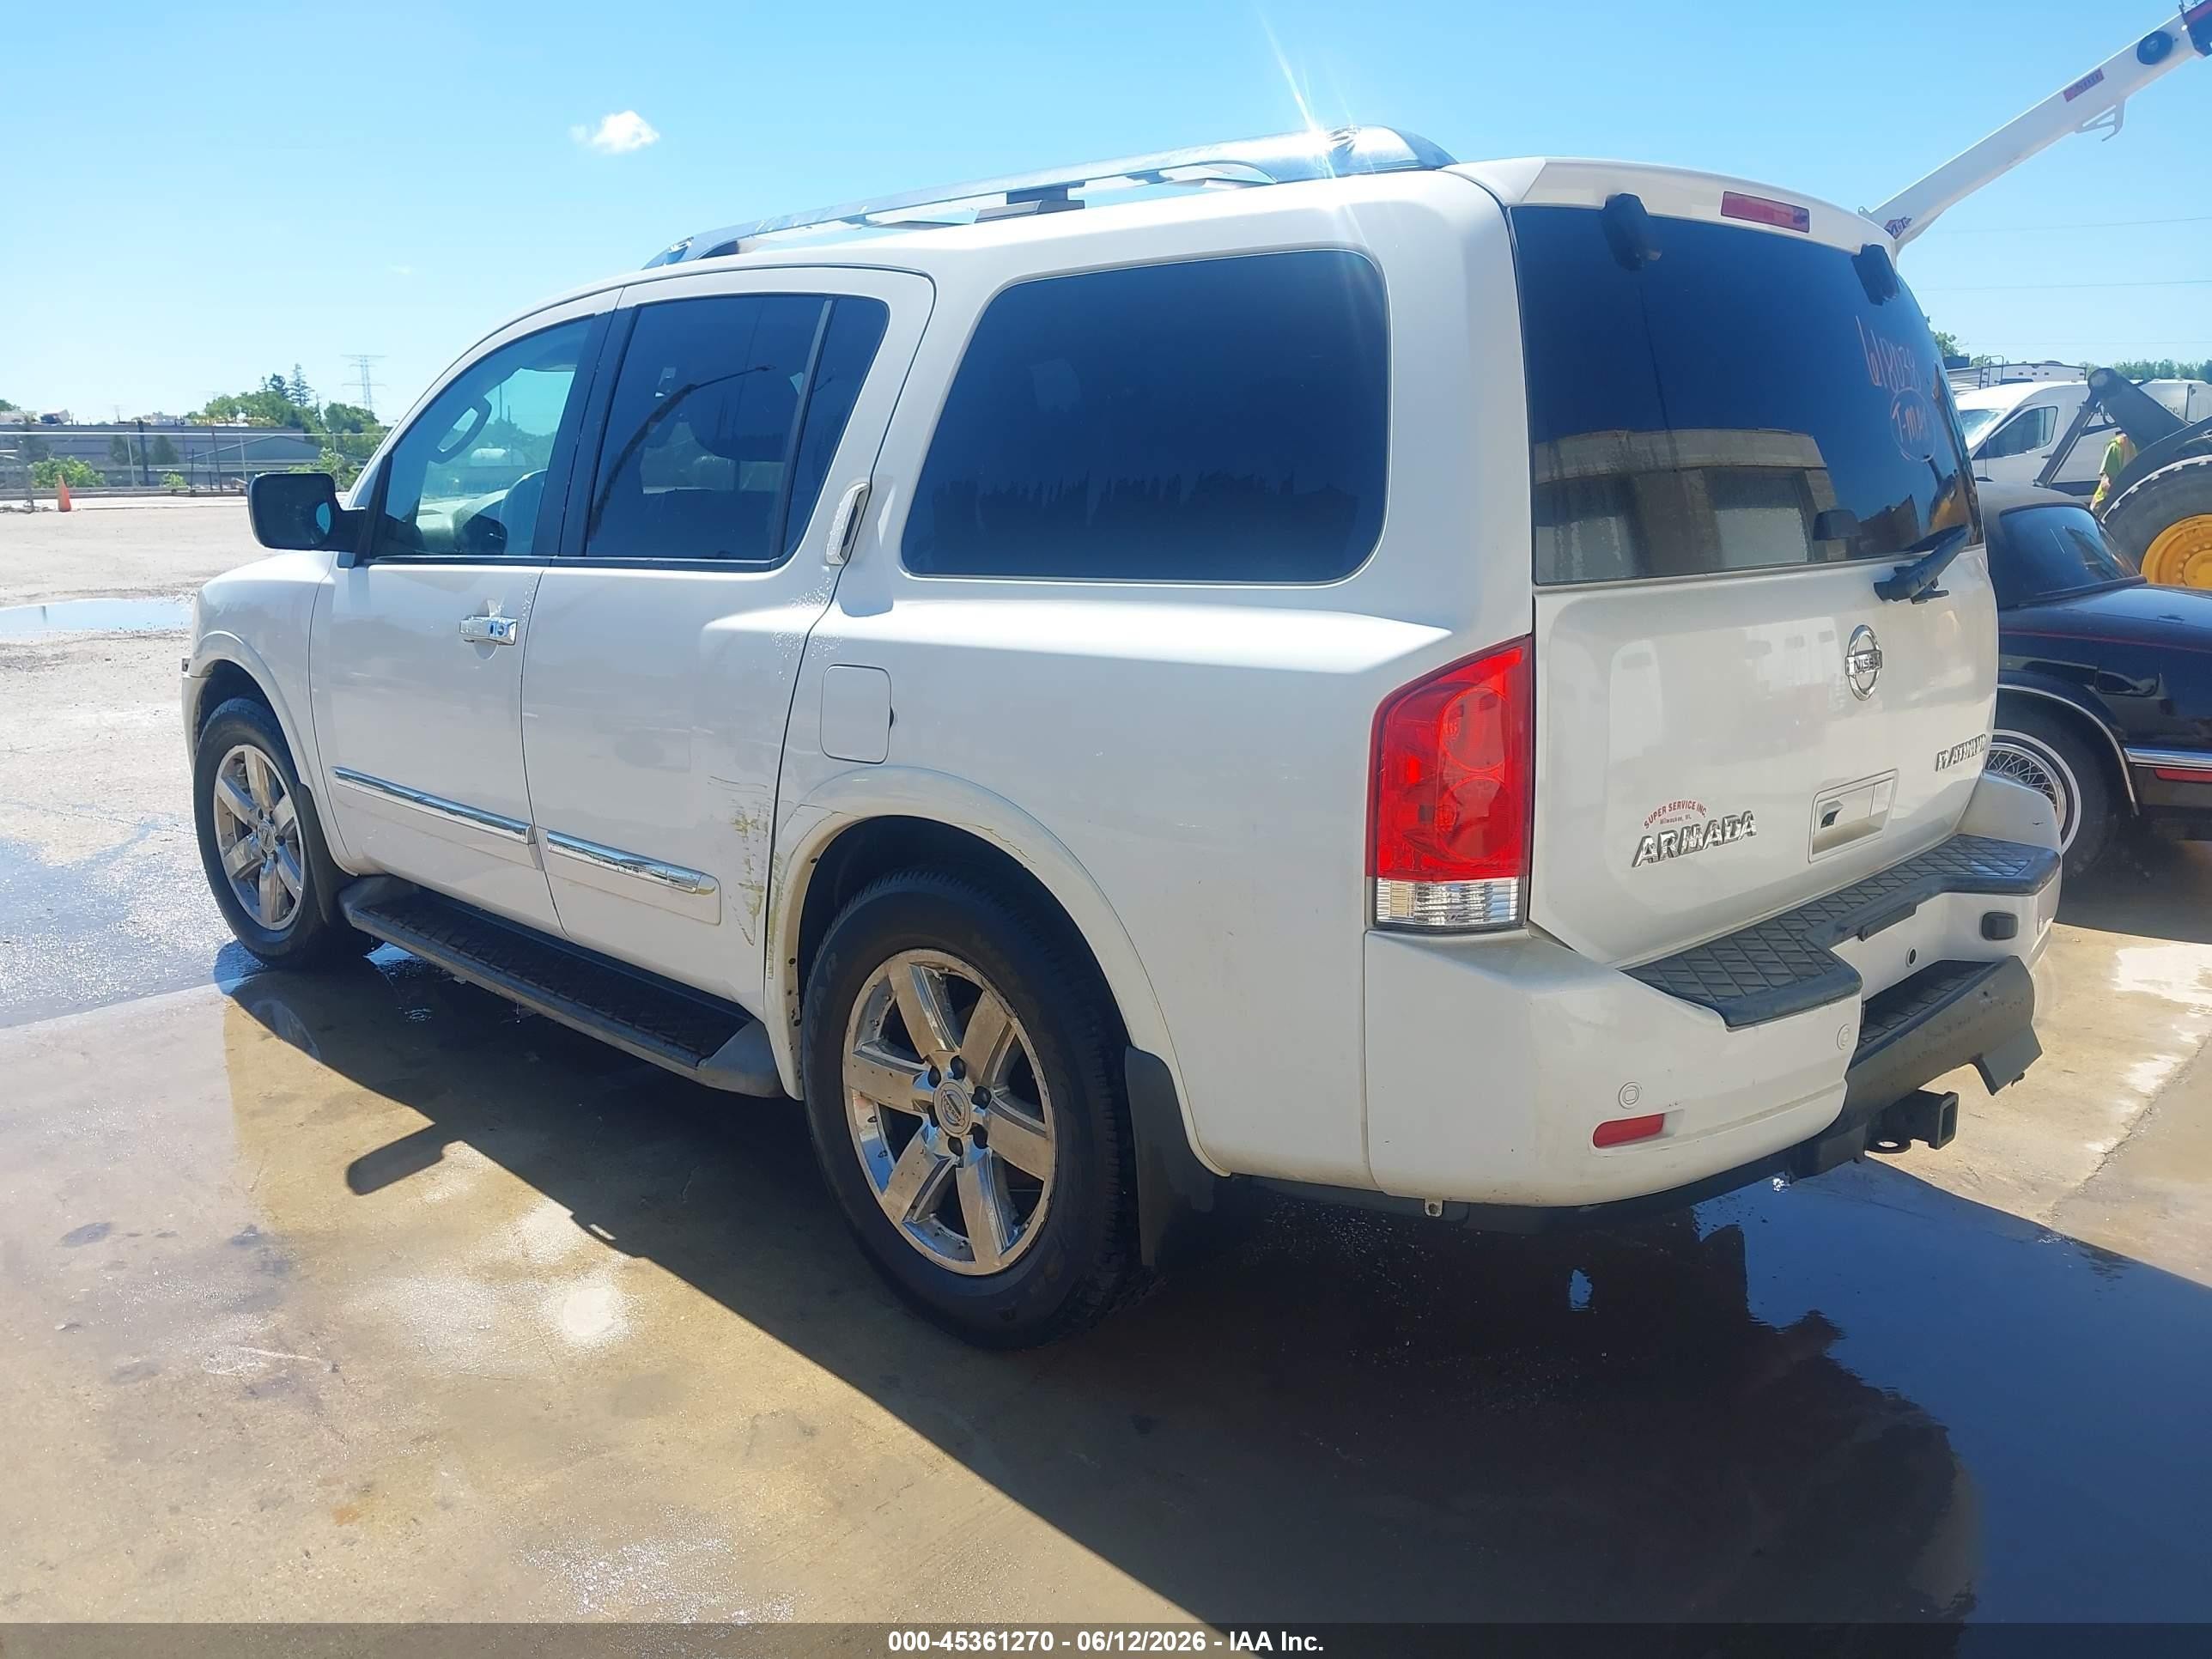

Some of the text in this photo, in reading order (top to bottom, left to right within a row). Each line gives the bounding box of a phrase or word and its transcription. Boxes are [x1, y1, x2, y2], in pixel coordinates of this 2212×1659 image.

[1644, 799, 1707, 830] SUPER SERVICE INC.
[1632, 810, 1757, 868] ARMADA
